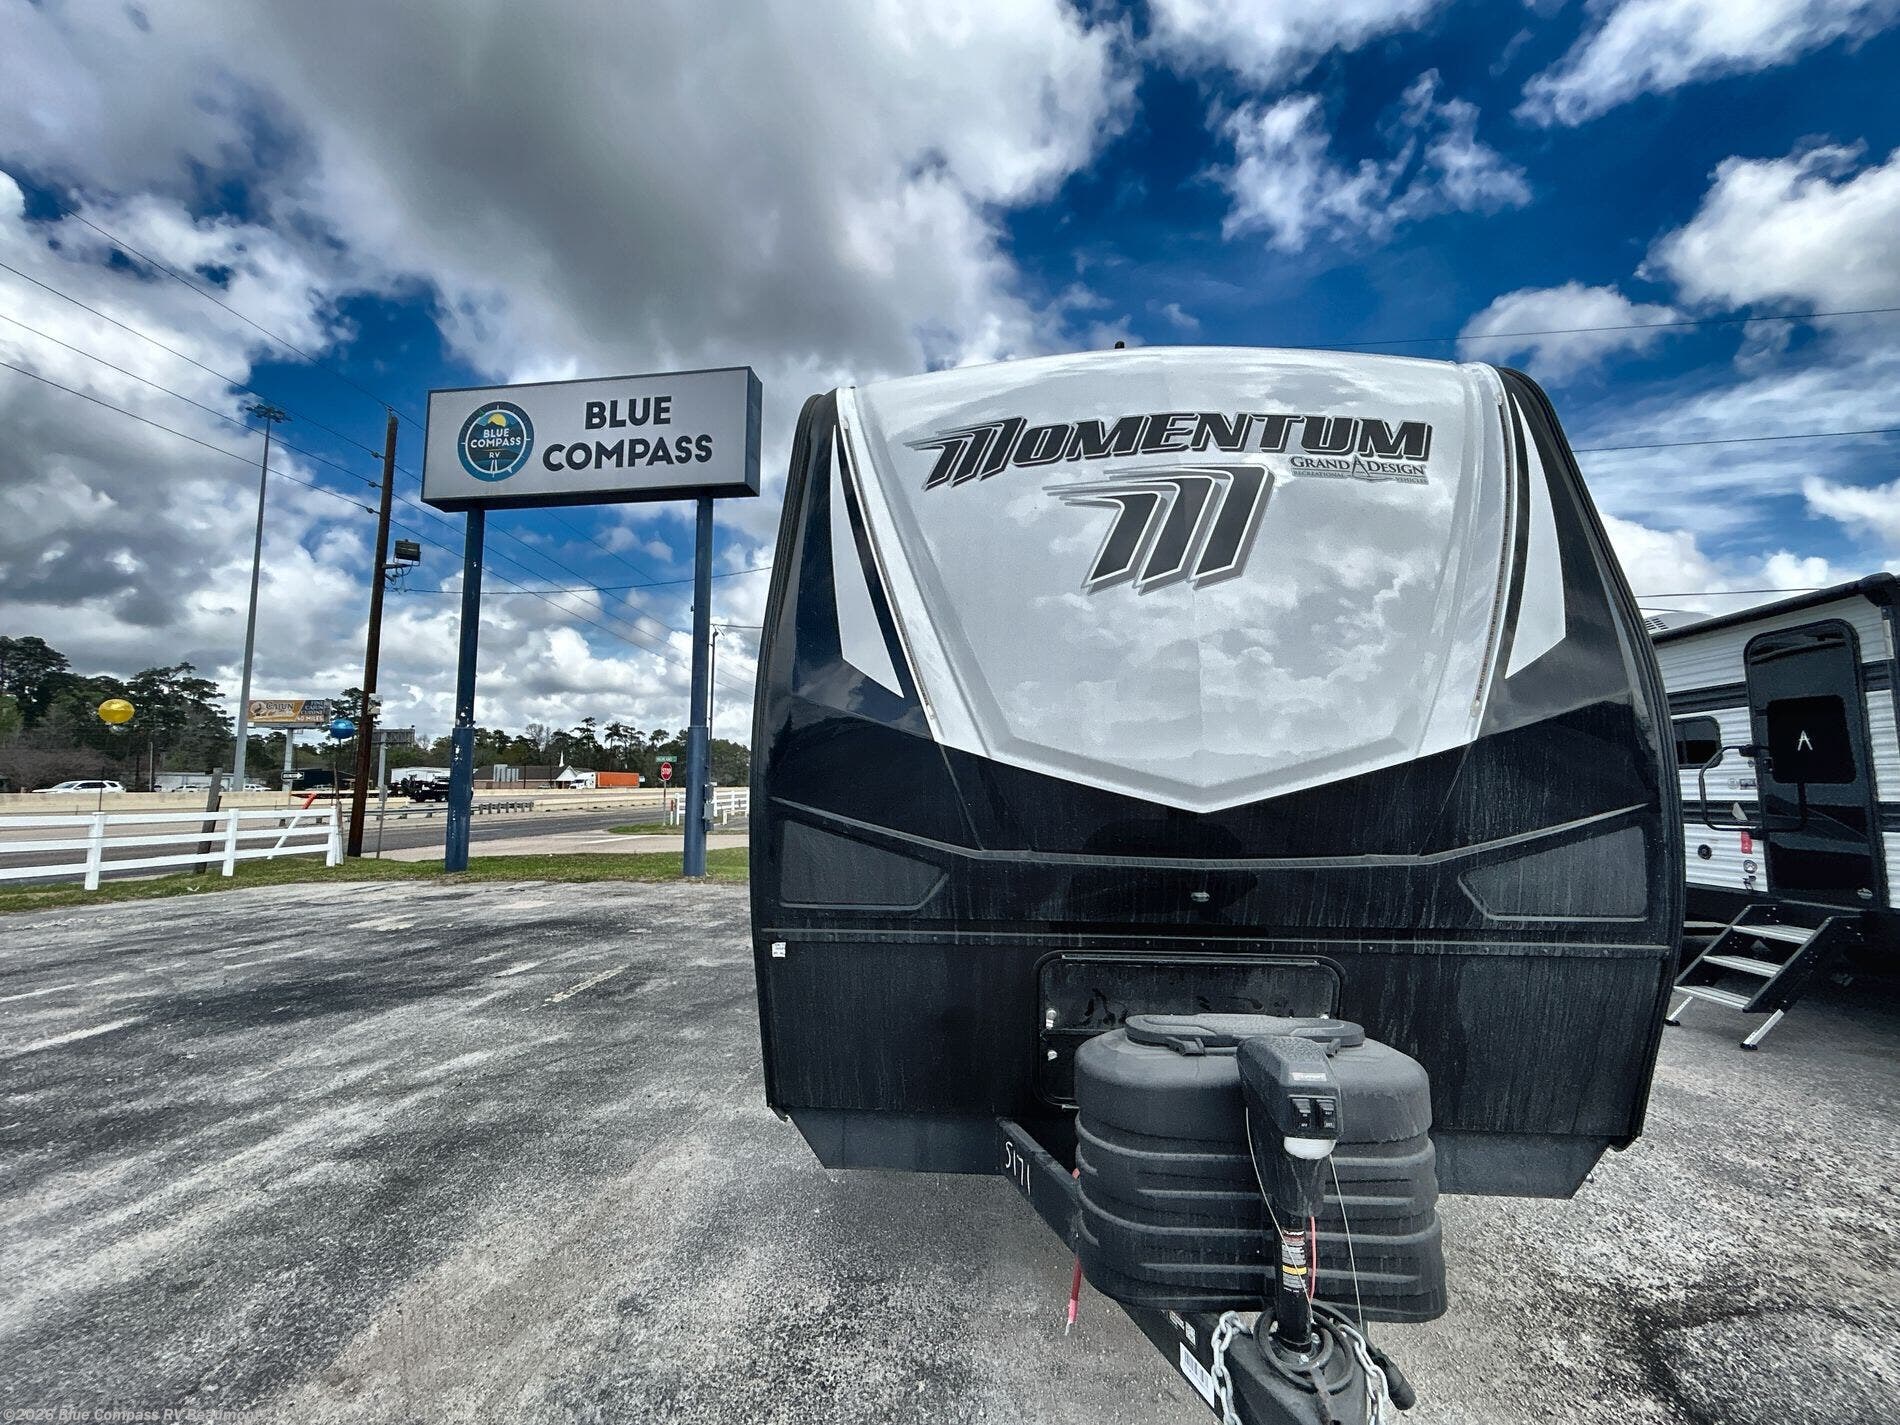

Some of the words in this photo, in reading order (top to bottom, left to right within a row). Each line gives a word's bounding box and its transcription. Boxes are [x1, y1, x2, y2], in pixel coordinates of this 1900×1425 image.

[585, 396, 672, 430] BLUE
[470, 437, 521, 448] COMPASS
[483, 428, 510, 438] BLUE
[542, 434, 713, 471] COMPASS
[902, 412, 1433, 492] MOMENTUM
[1290, 456, 1350, 469] GRAND
[1366, 461, 1424, 475] DESIGN
[266, 702, 294, 711] CAJUN
